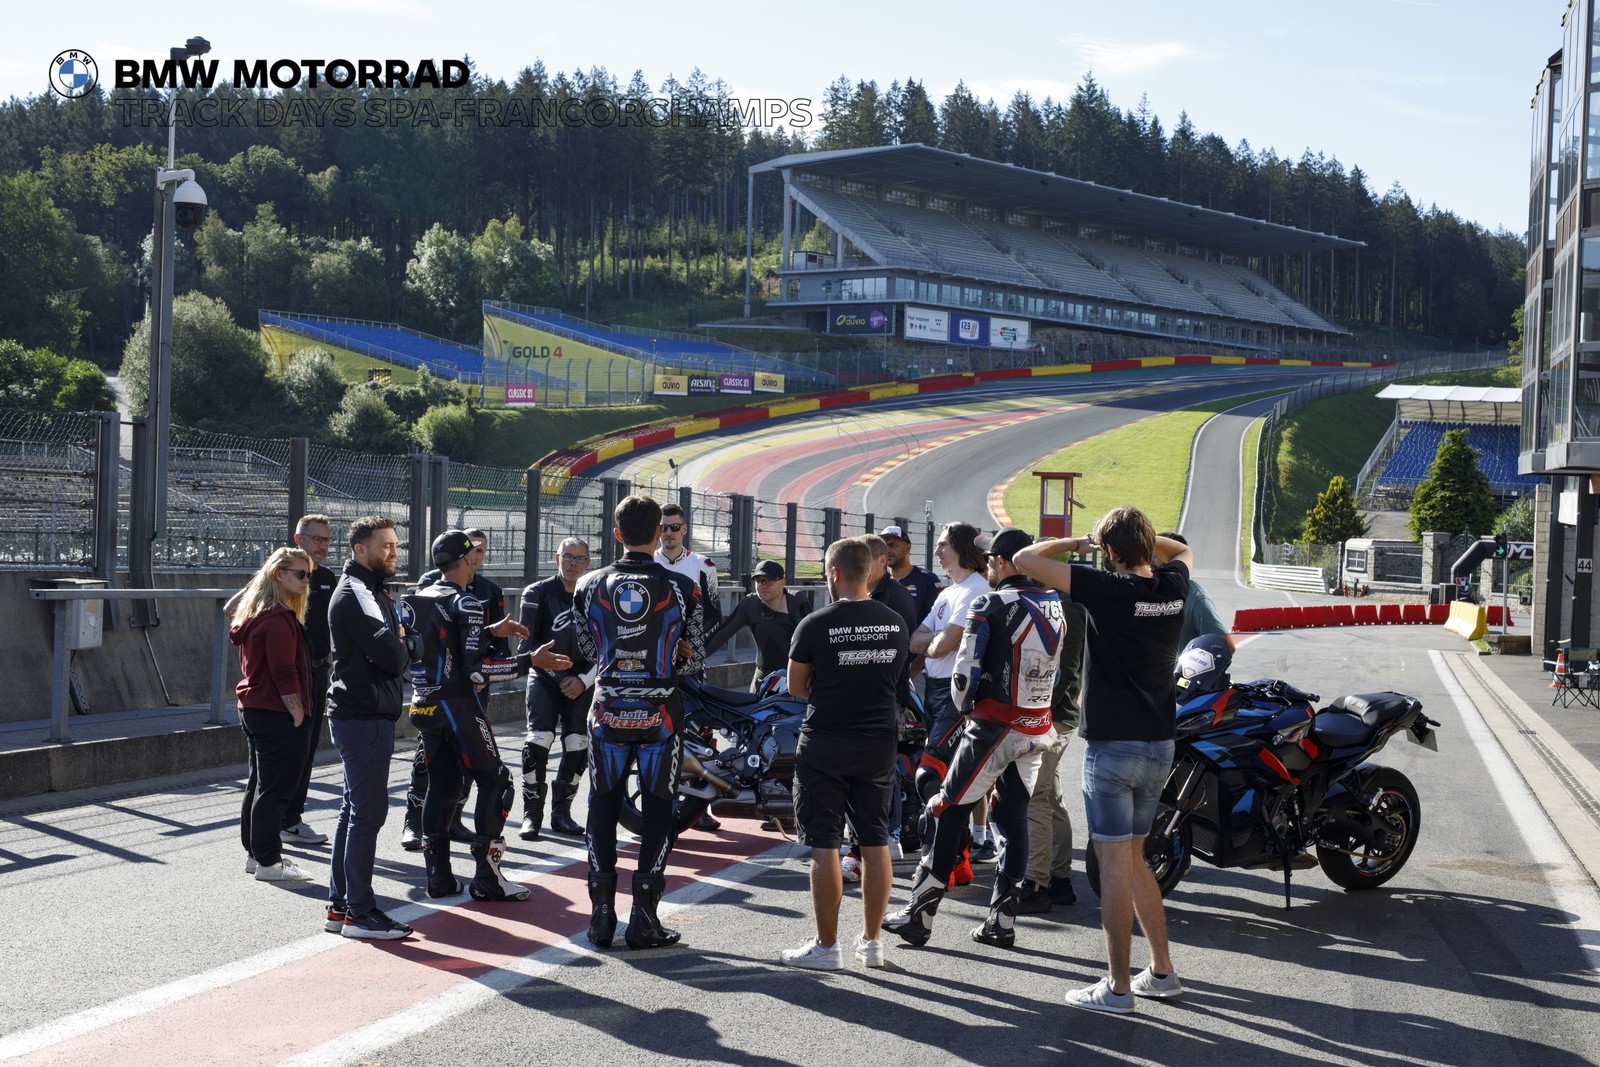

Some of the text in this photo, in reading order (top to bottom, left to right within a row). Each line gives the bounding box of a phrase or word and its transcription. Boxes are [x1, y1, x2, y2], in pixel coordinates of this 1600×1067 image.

[960, 321, 971, 331] 123
[512, 346, 563, 359] GOLD 4
[662, 381, 680, 390] auvio
[690, 379, 712, 388] AISIN
[723, 378, 743, 387] CLASSIC
[761, 378, 778, 387] auvio
[508, 388, 527, 398] CLASSIC
[1578, 559, 1592, 571] 44
[617, 582, 646, 595] BMW
[1134, 599, 1184, 613] TECMAS
[829, 625, 900, 636] BMW MOTORRAD
[829, 633, 889, 644] MOTORSPORT
[838, 648, 898, 661] TECMAS
